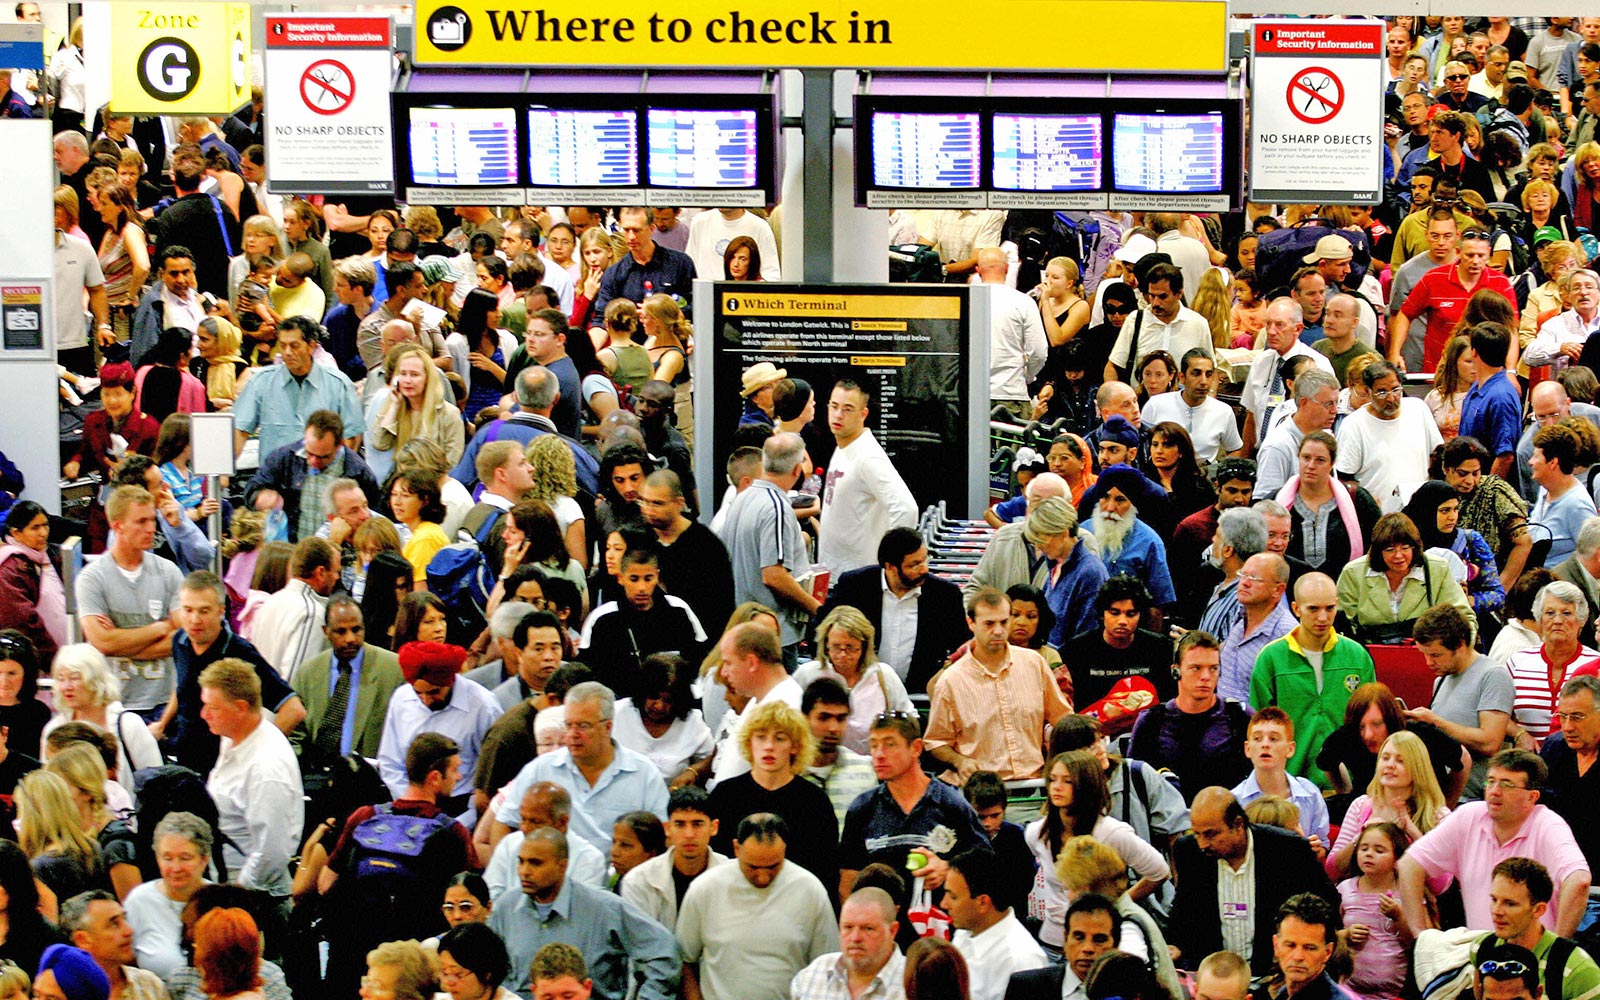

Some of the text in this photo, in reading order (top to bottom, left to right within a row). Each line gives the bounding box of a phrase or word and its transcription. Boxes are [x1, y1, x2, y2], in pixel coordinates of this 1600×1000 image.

[138, 11, 198, 28] Zone
[287, 23, 335, 32] Important
[486, 10, 892, 44] Where to check in
[287, 33, 326, 42] Security
[1277, 30, 1326, 39] Important
[1277, 40, 1316, 50] Security
[144, 43, 191, 93] G
[275, 126, 384, 136] NO SHARP OBJECTS
[1260, 134, 1372, 145] NO SHARP OBJECTS
[744, 299, 847, 310] Which Terminal
